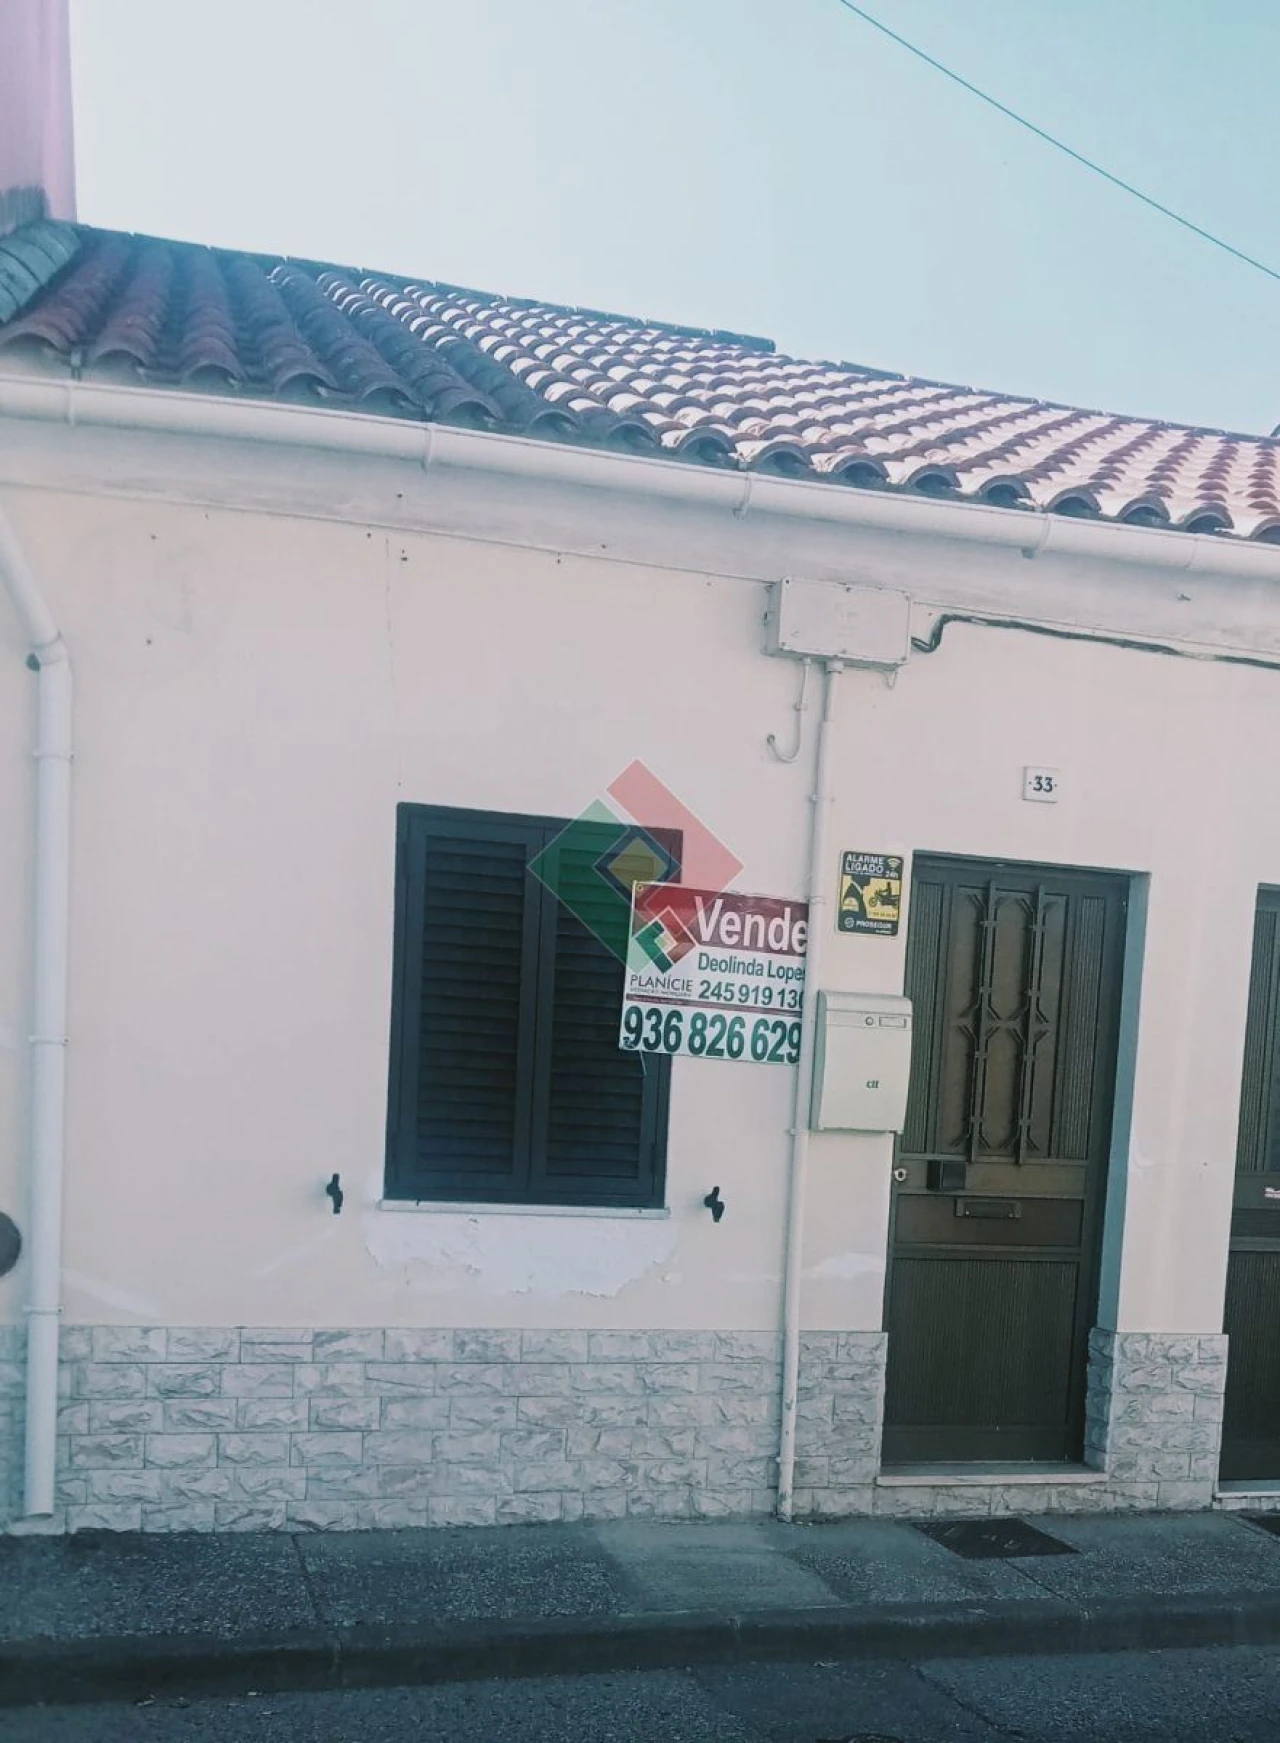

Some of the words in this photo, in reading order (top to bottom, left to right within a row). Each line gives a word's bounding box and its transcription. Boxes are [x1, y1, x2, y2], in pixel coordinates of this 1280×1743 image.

[1033, 776, 1053, 793] 33
[845, 862, 884, 874] LIGADO
[846, 853, 884, 865] ALARME
[694, 895, 808, 954] Vende
[698, 952, 764, 977] Deolinda
[630, 974, 694, 993] PLANÍCIE
[698, 979, 735, 1002] 245
[738, 984, 773, 1006] 919
[624, 1005, 683, 1053] 936
[688, 1011, 746, 1060] 826
[751, 1018, 801, 1065] 629
